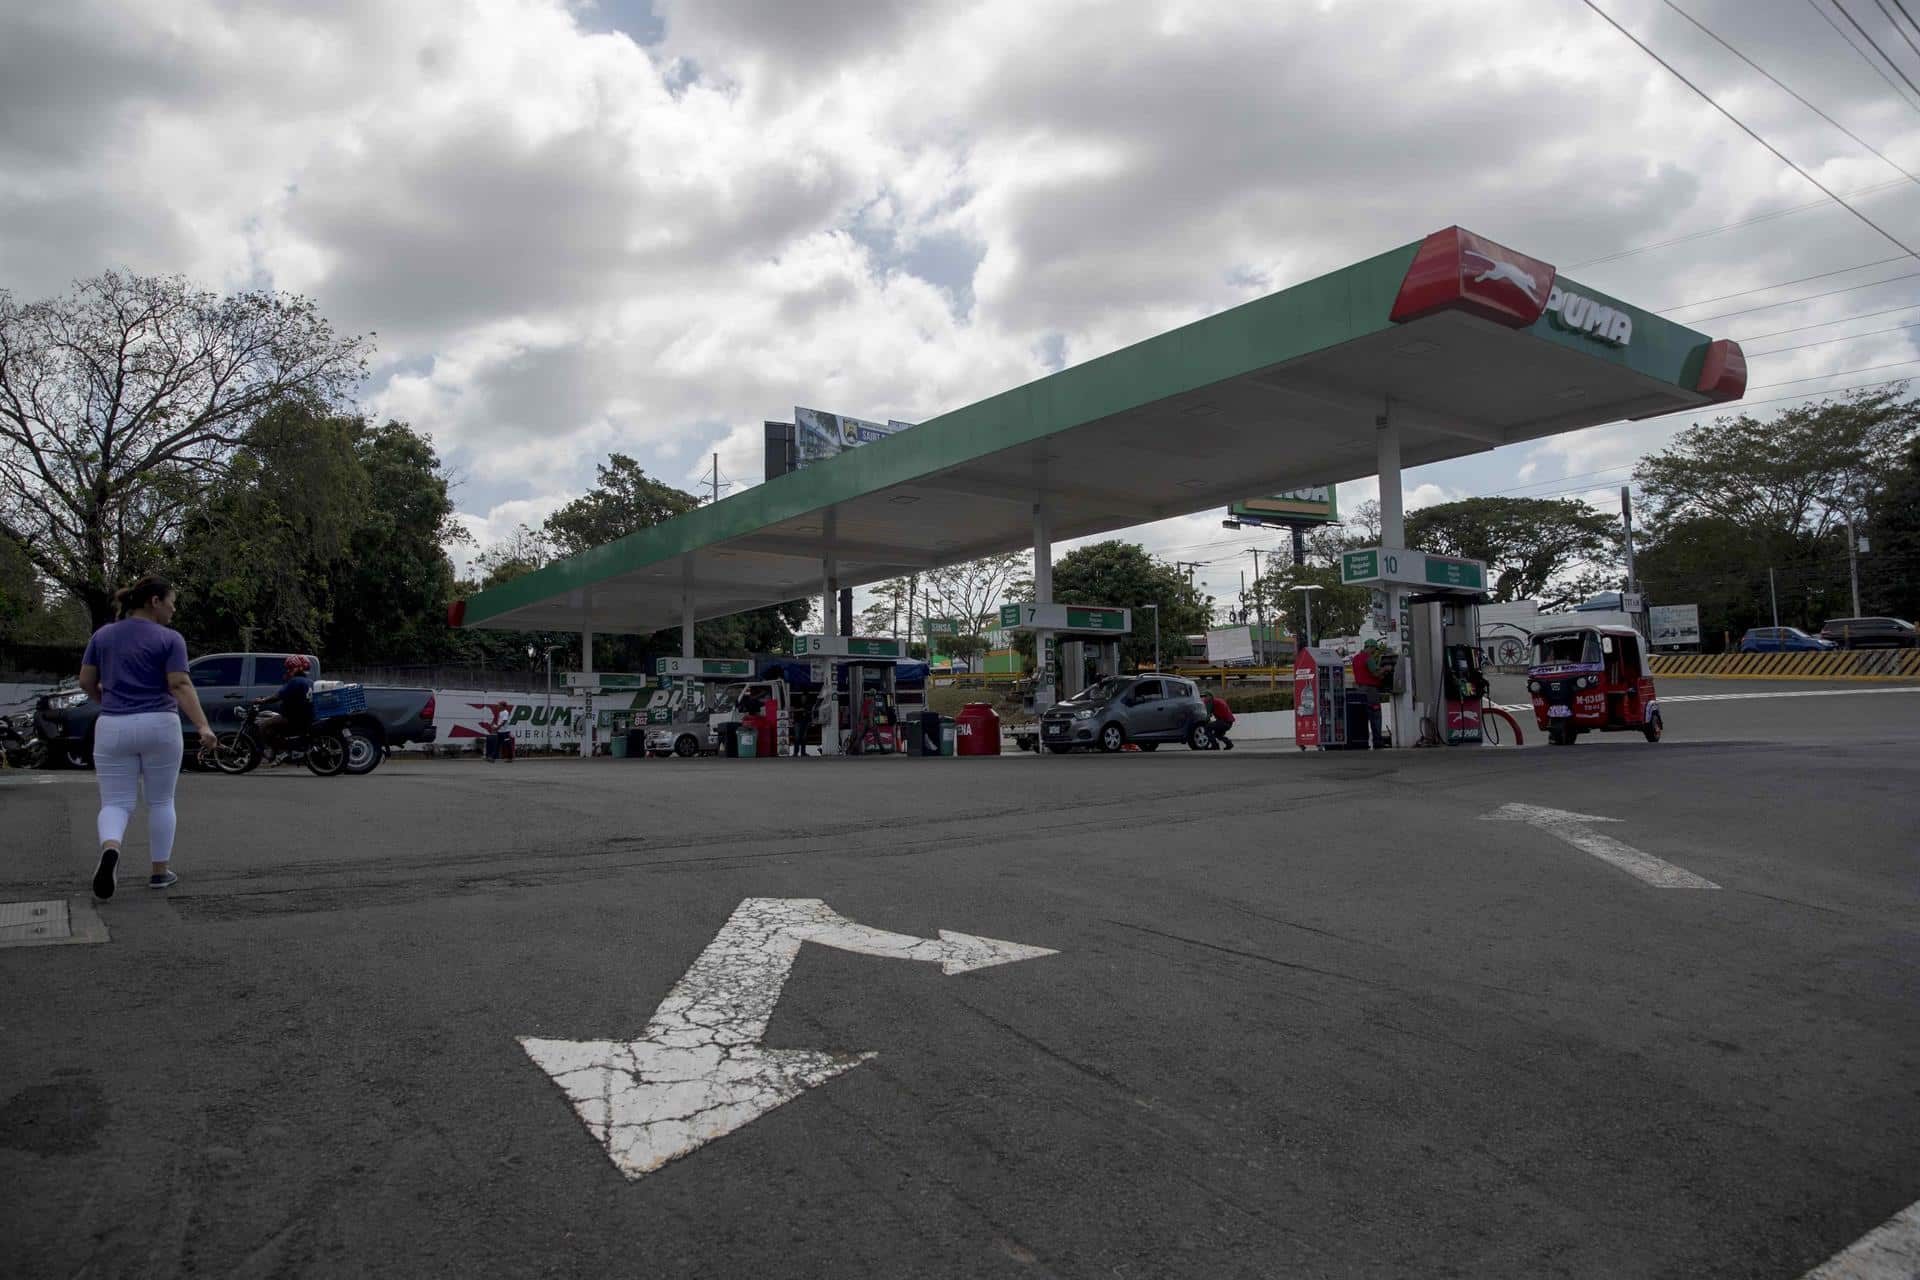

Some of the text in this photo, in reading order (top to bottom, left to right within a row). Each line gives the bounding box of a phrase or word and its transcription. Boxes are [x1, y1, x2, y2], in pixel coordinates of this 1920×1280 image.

[1384, 556, 1398, 574] 10
[1027, 608, 1036, 622] 7
[813, 639, 820, 650] 5
[671, 660, 679, 671] 3
[509, 705, 572, 726] PUM
